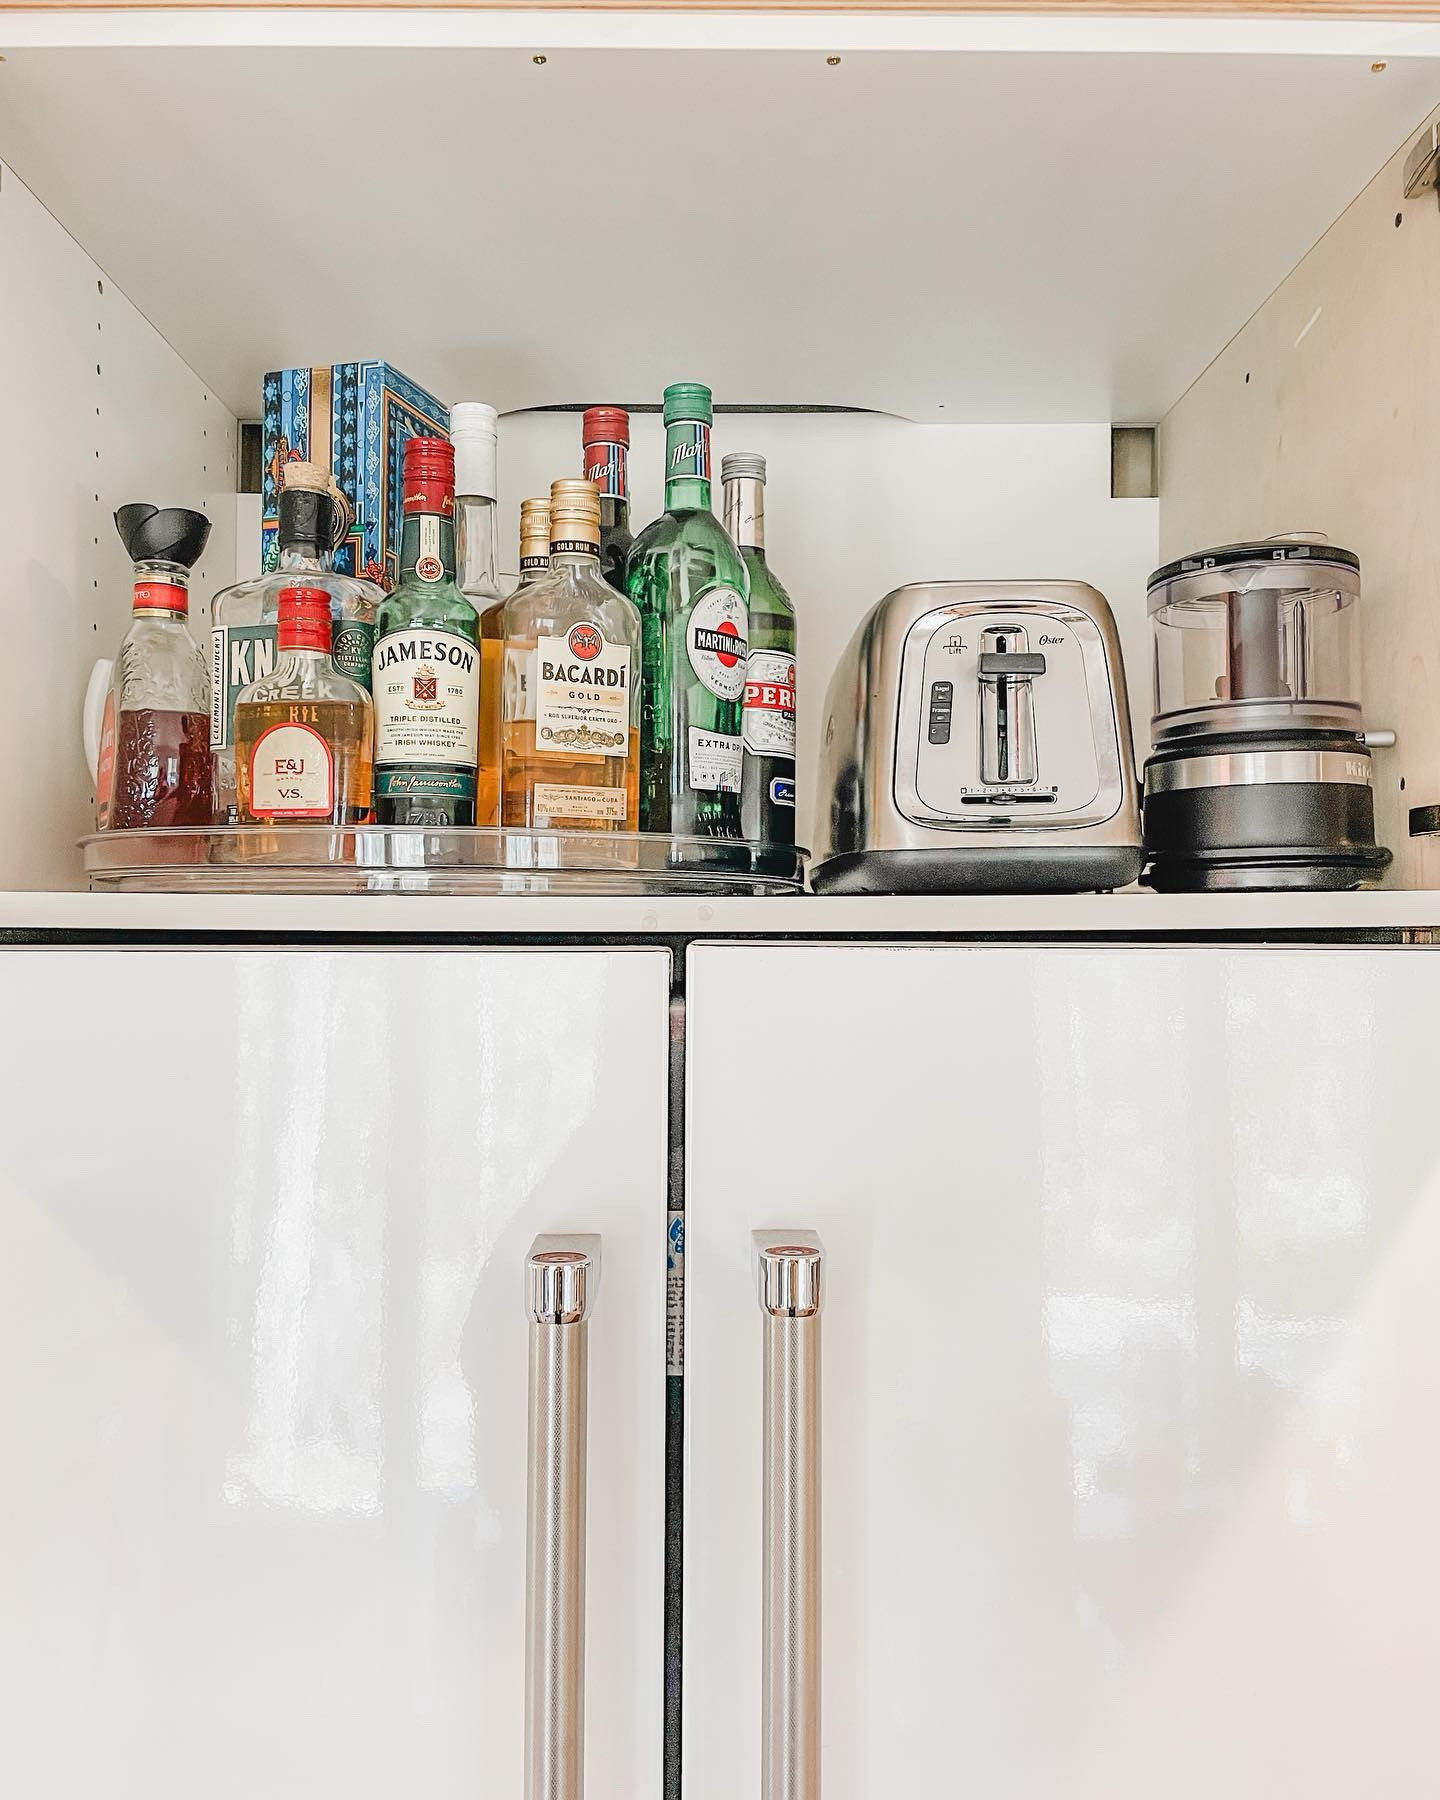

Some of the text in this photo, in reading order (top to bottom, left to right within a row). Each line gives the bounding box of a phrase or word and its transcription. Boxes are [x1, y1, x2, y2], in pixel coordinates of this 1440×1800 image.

[556, 542, 590, 552] GOLD RUM
[523, 558, 539, 567] GOLD
[1039, 634, 1064, 646] Oster
[378, 640, 474, 674] JAMESON
[542, 661, 626, 689] BACARDÍ
[447, 687, 463, 695] 1780
[568, 691, 600, 701] GOLD
[213, 689, 221, 740] CLERMONT,
[289, 705, 320, 723] RYE
[390, 715, 461, 725] TRIPLE DISTILLED
[418, 740, 457, 748] WHISKEY
[697, 739, 730, 750] EXTRA
[275, 758, 305, 775] E&J
[278, 788, 304, 799] V.S.
[565, 794, 596, 802] SANTIAGO
